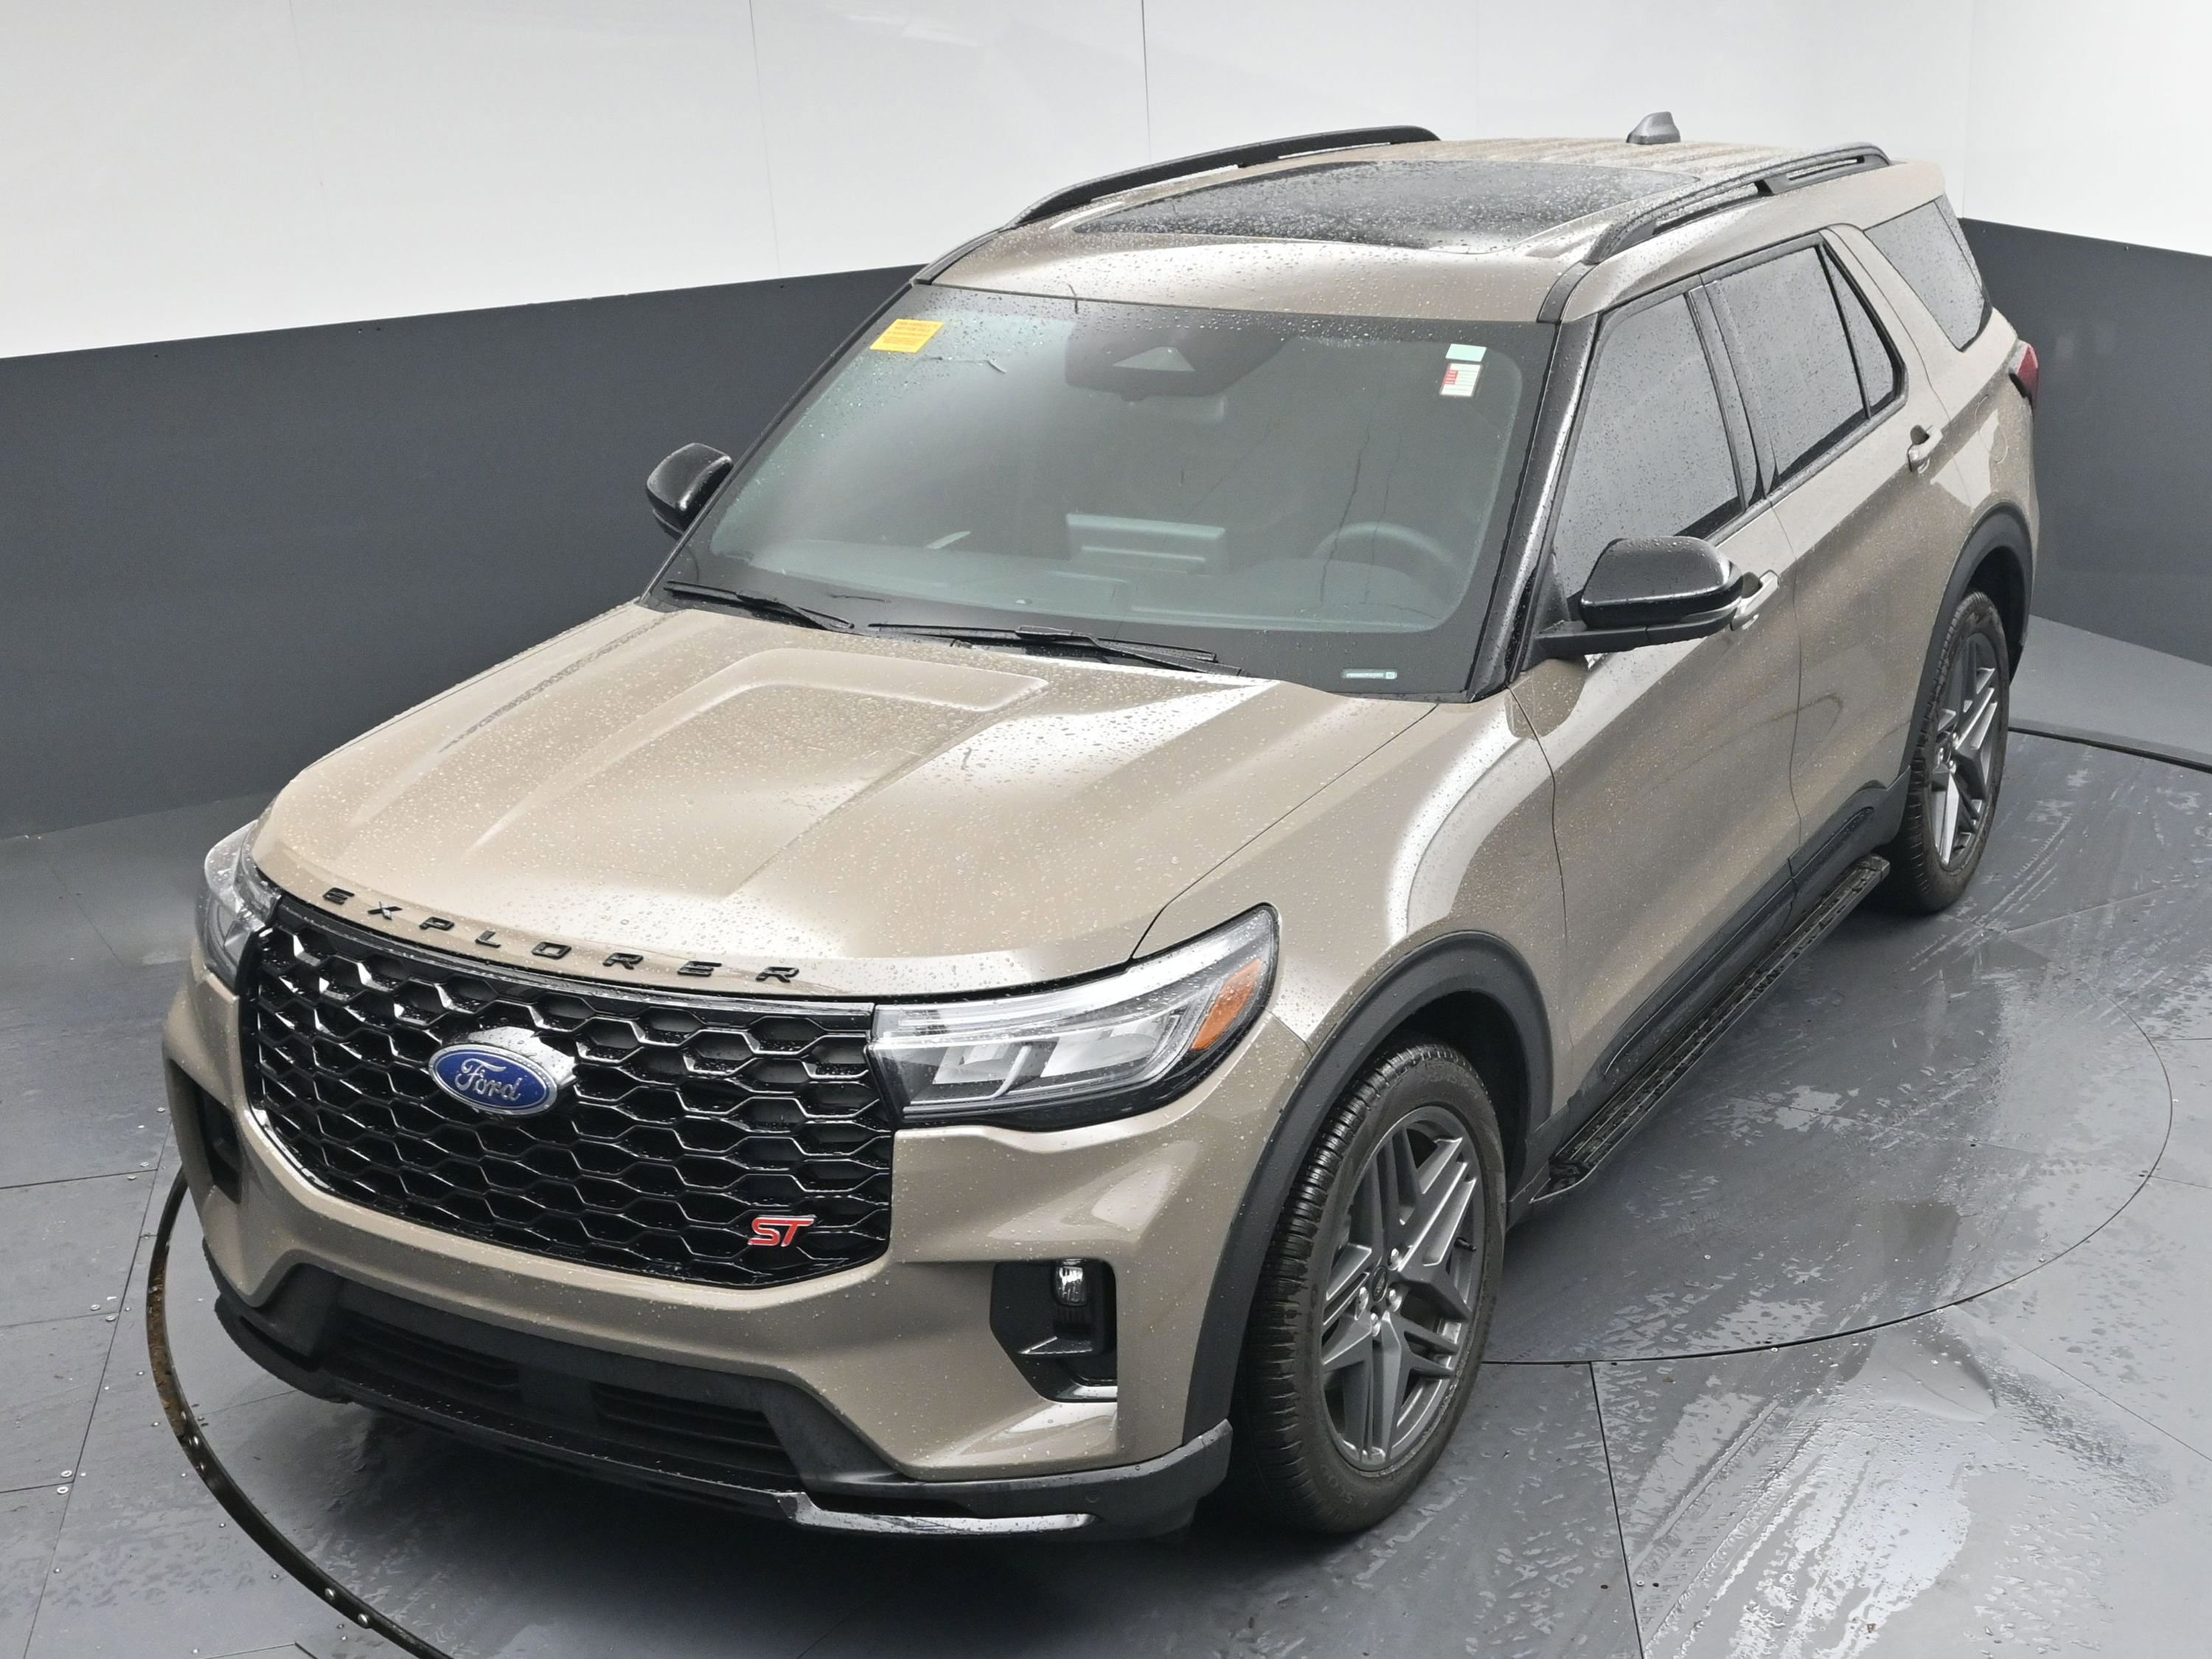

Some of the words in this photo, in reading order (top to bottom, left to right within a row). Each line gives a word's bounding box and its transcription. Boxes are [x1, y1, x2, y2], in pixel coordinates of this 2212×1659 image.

[322, 886, 801, 984] EXPLORER
[454, 1057, 522, 1101] Ford
[747, 1215, 815, 1247] ST
